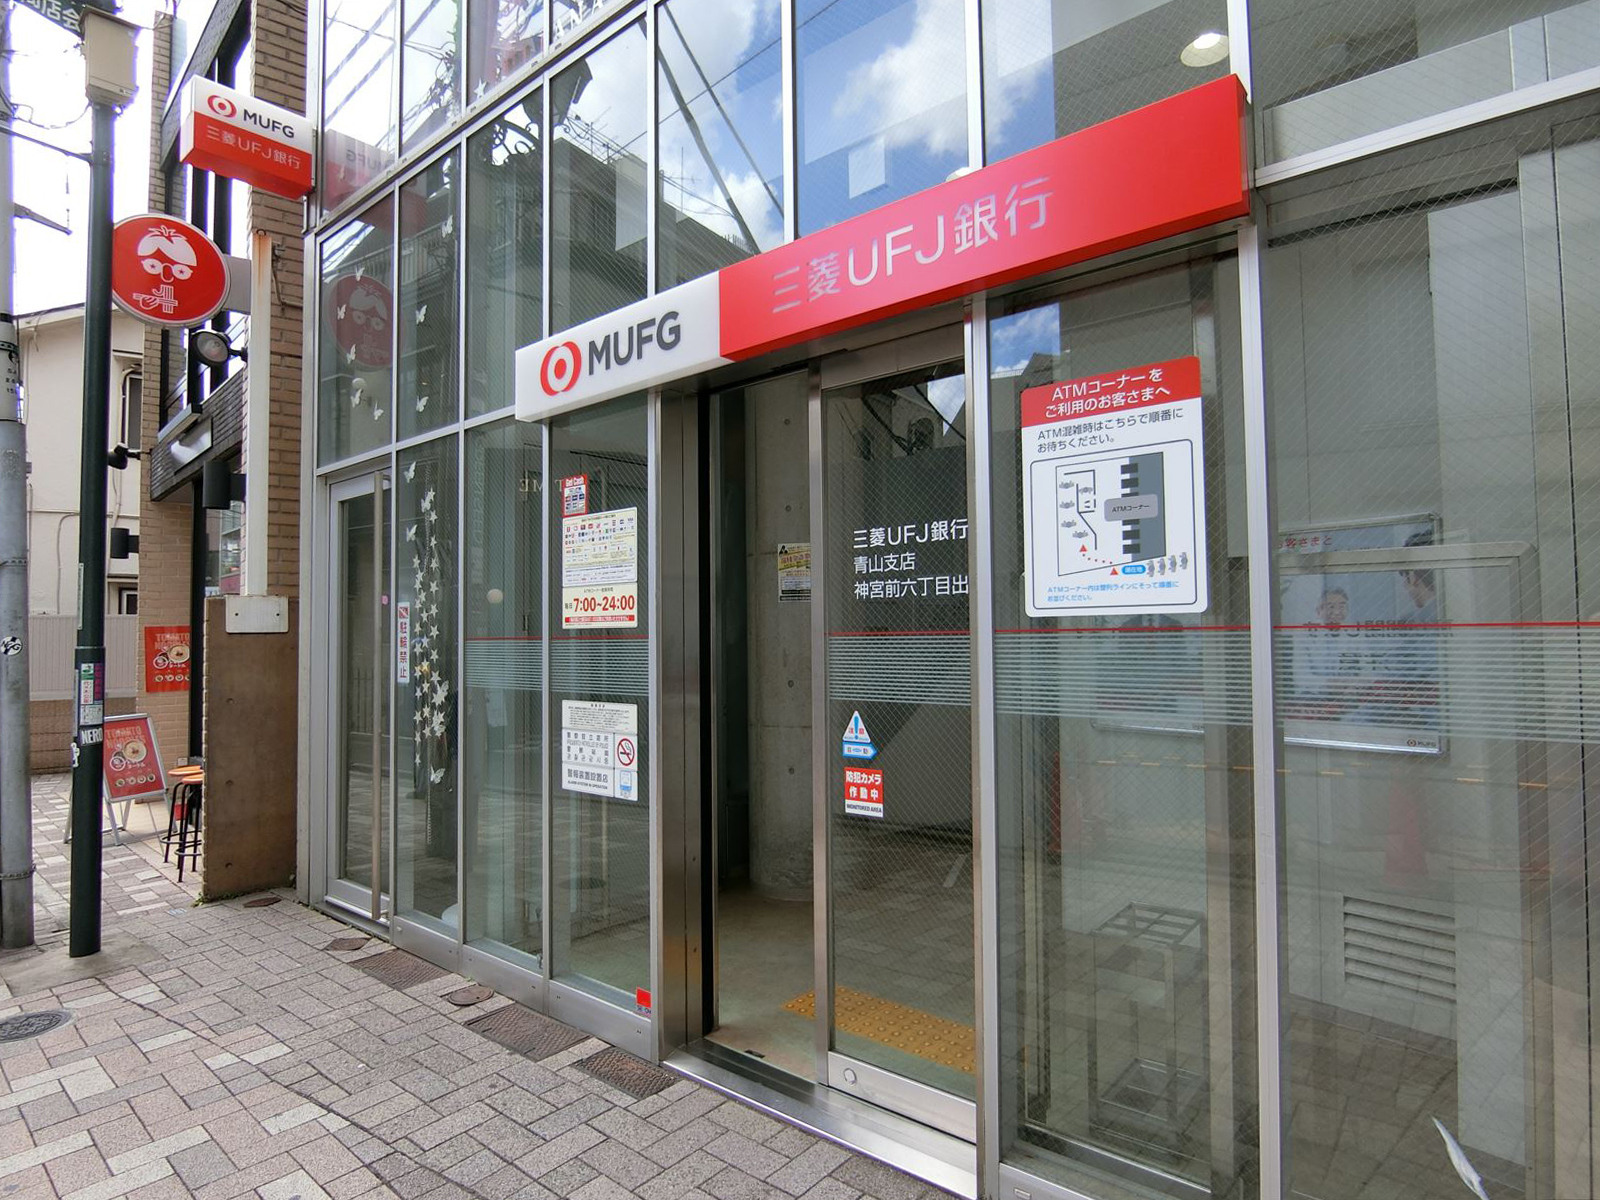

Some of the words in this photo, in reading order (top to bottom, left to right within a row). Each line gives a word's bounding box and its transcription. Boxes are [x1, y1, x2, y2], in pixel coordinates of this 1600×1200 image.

[244, 109, 295, 138] MUFG
[207, 125, 300, 169] 三菱UFJ銀行
[772, 176, 1054, 313] 三菱UFJ銀行
[589, 311, 680, 376] MUFG
[1052, 368, 1163, 401] ATMコーナーを
[1045, 386, 1170, 418] ご利用のお客さまへ
[1037, 407, 1184, 441] ATM混雑時はこちらで順番に
[1037, 434, 1115, 454] お待ちください。
[1111, 503, 1150, 513] ATMコーナー
[853, 518, 969, 549] 三菱UFJ銀行
[853, 551, 916, 574] 青山支店
[853, 574, 969, 600] 神宮前六丁目出
[845, 770, 882, 785] 防犯カメラ
